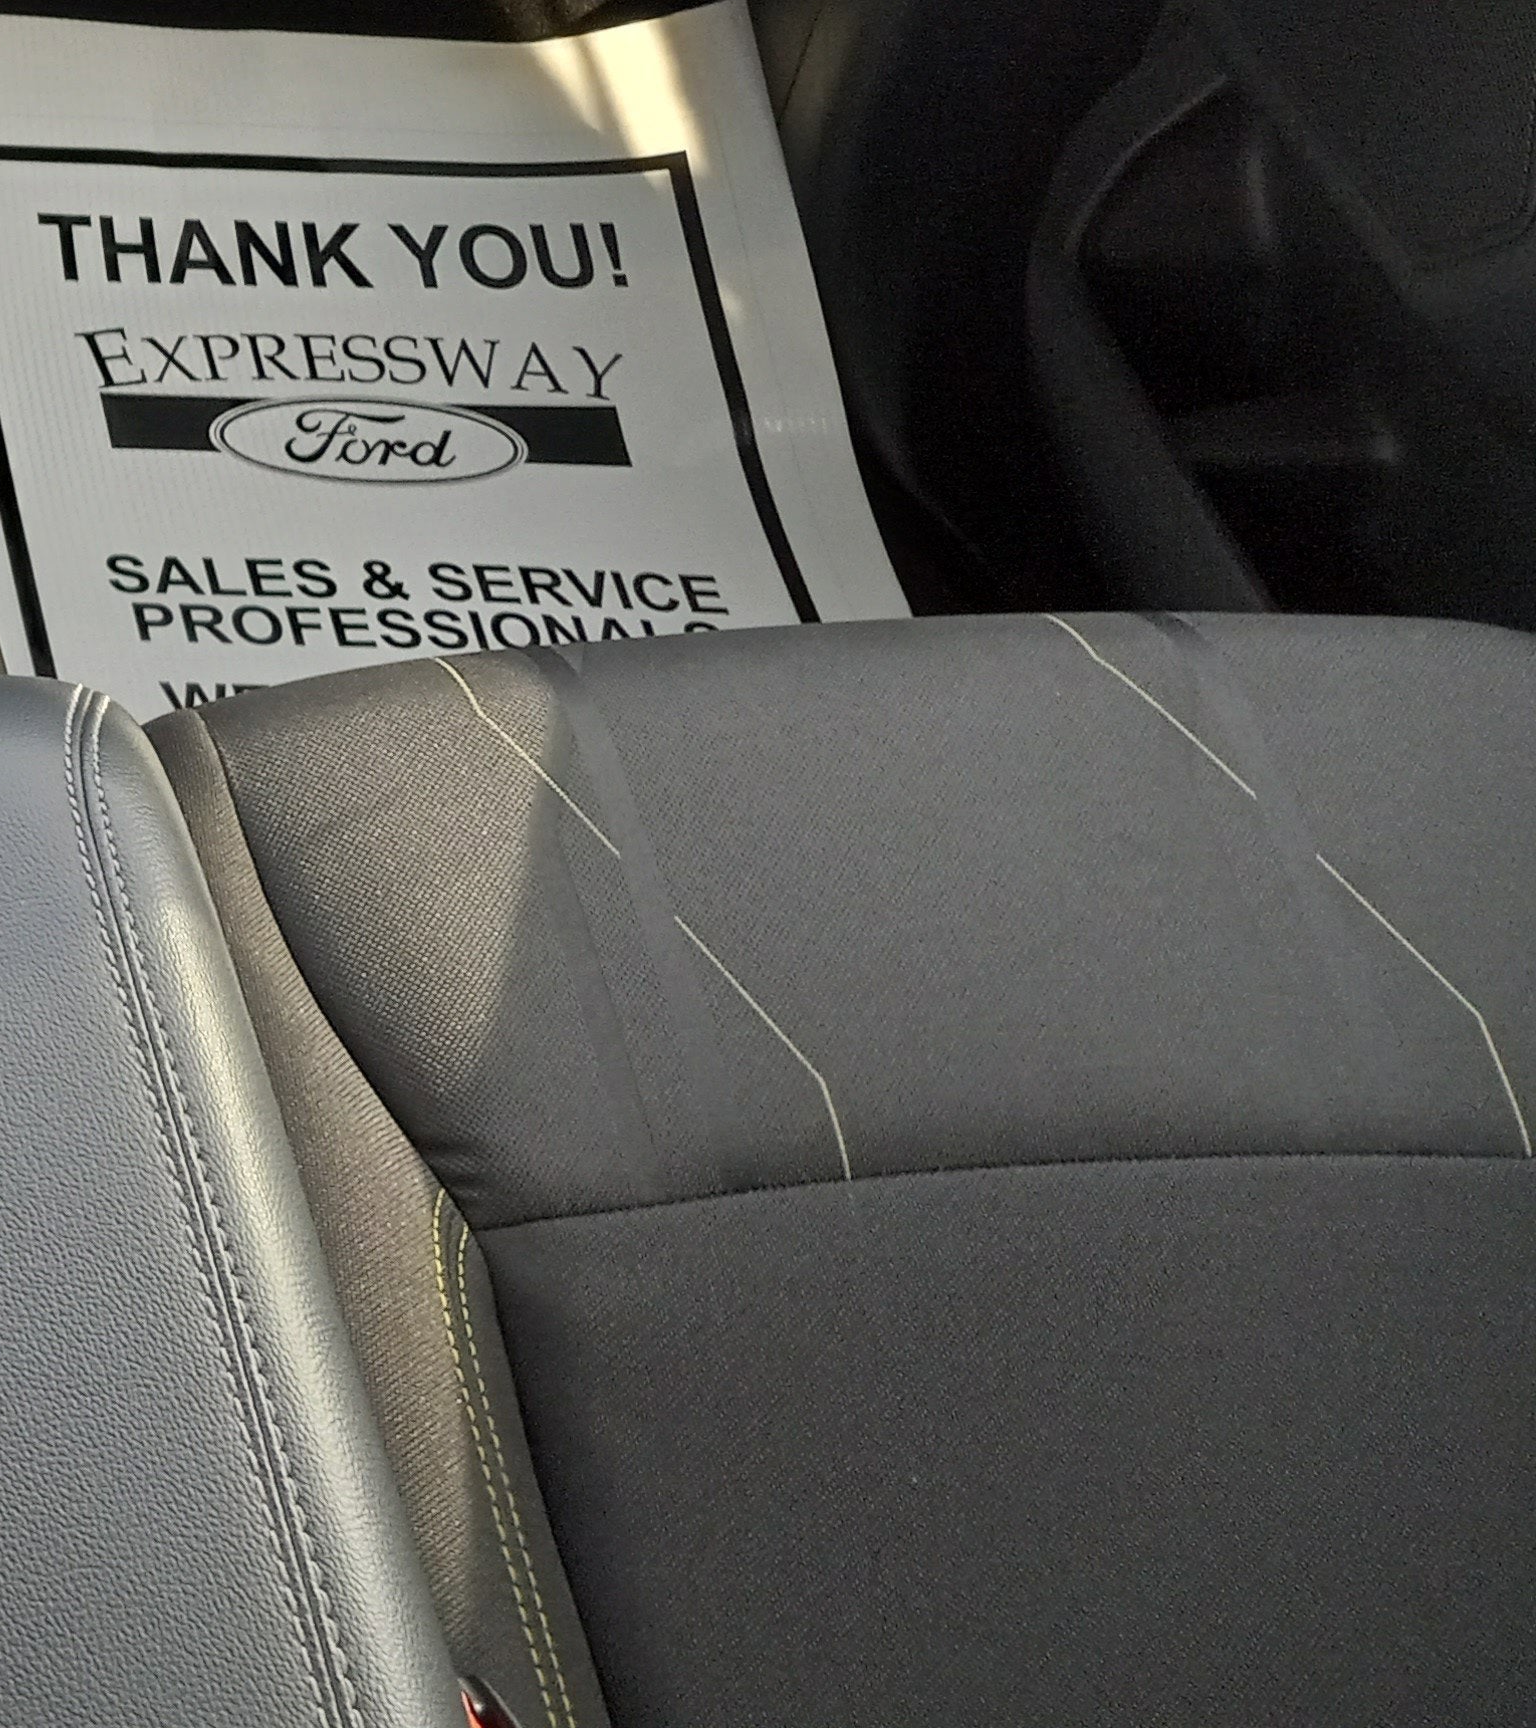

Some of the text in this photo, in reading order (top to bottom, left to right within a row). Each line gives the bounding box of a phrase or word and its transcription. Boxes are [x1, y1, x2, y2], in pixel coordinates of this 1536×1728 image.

[37, 213, 630, 288] THANK YOU!
[284, 408, 456, 468] Ford
[106, 553, 729, 615] SALES & SERVICE
[131, 601, 722, 651] PROFESSIONA
